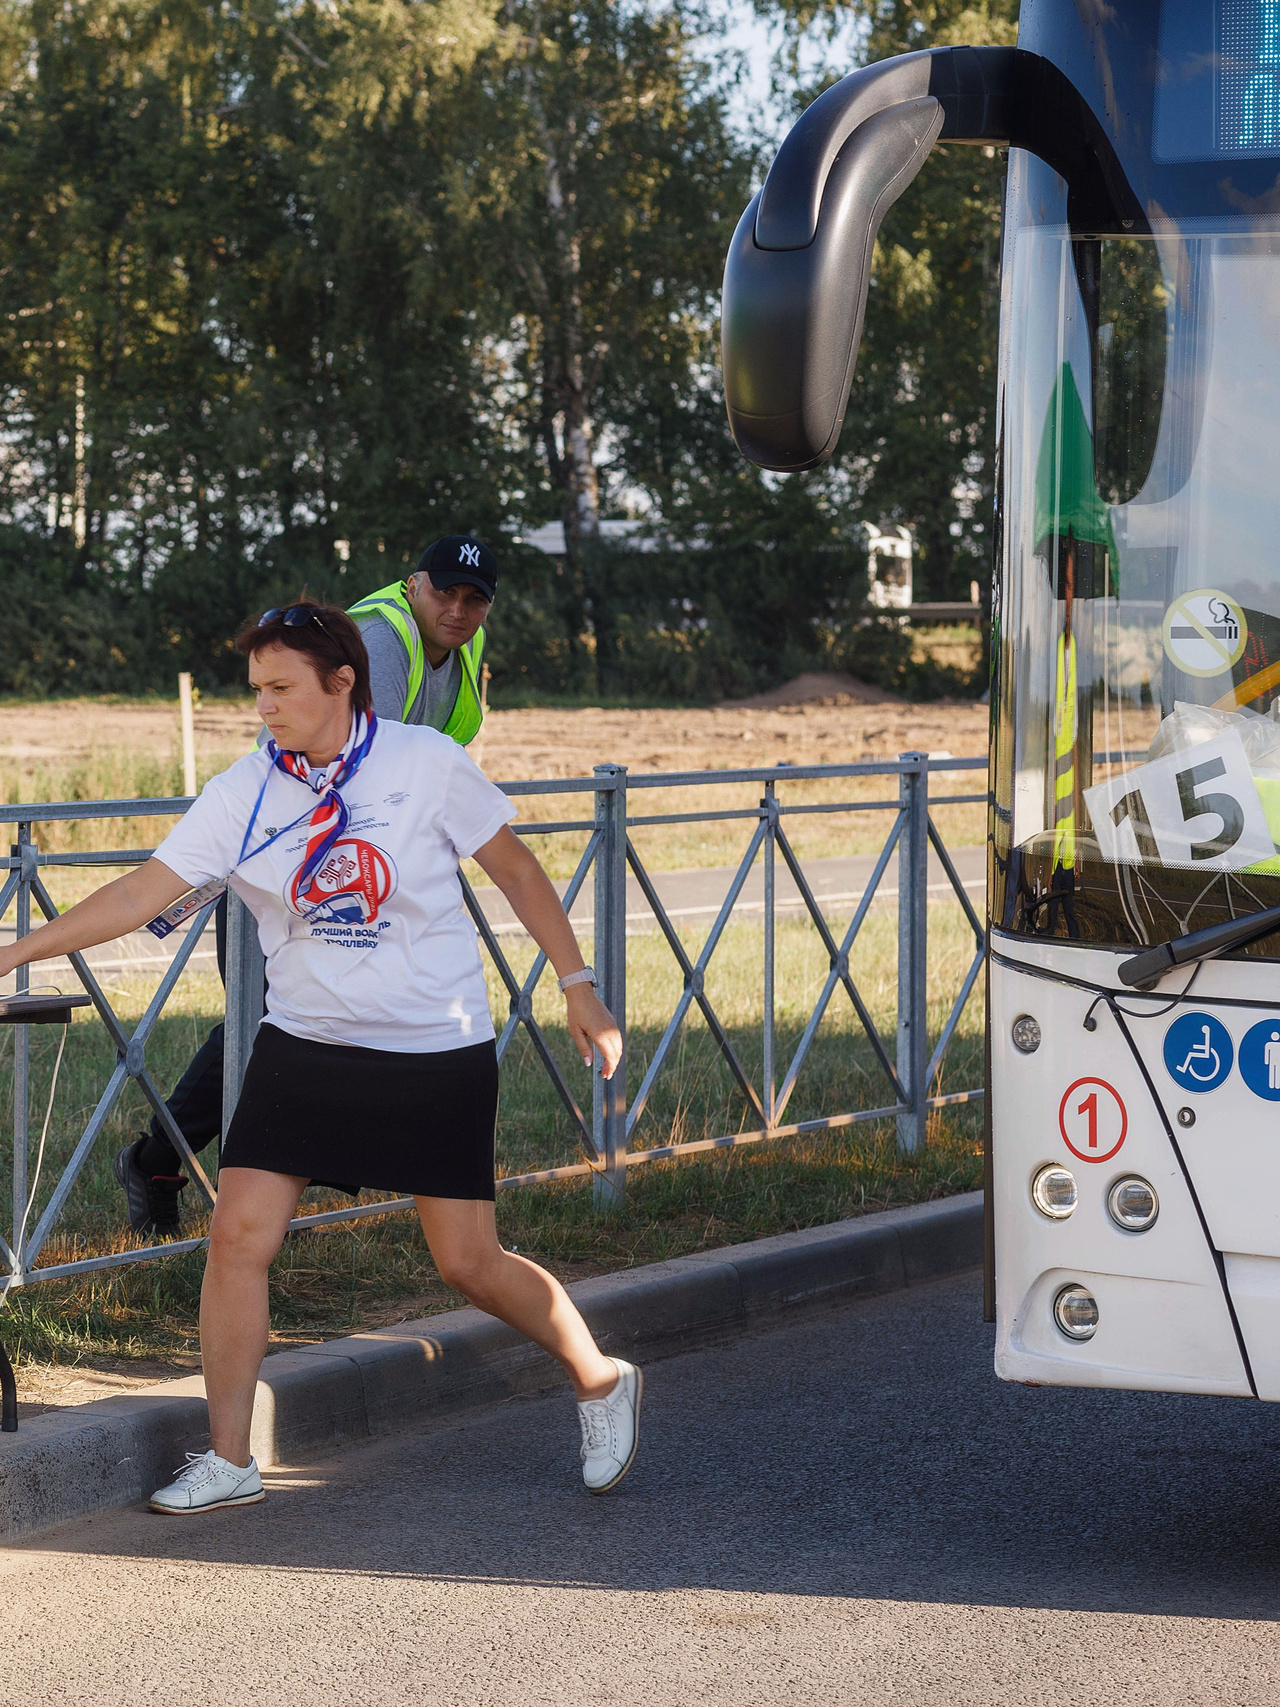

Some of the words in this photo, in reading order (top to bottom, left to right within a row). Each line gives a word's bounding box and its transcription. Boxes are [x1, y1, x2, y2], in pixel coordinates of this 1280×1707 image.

[458, 543, 480, 567] NY
[1109, 756, 1245, 867] 15
[360, 849, 373, 895] ЧЕБОКСАРЫ
[310, 927, 353, 937] ЛУЧШИЙ
[1077, 1092, 1098, 1149] 1
